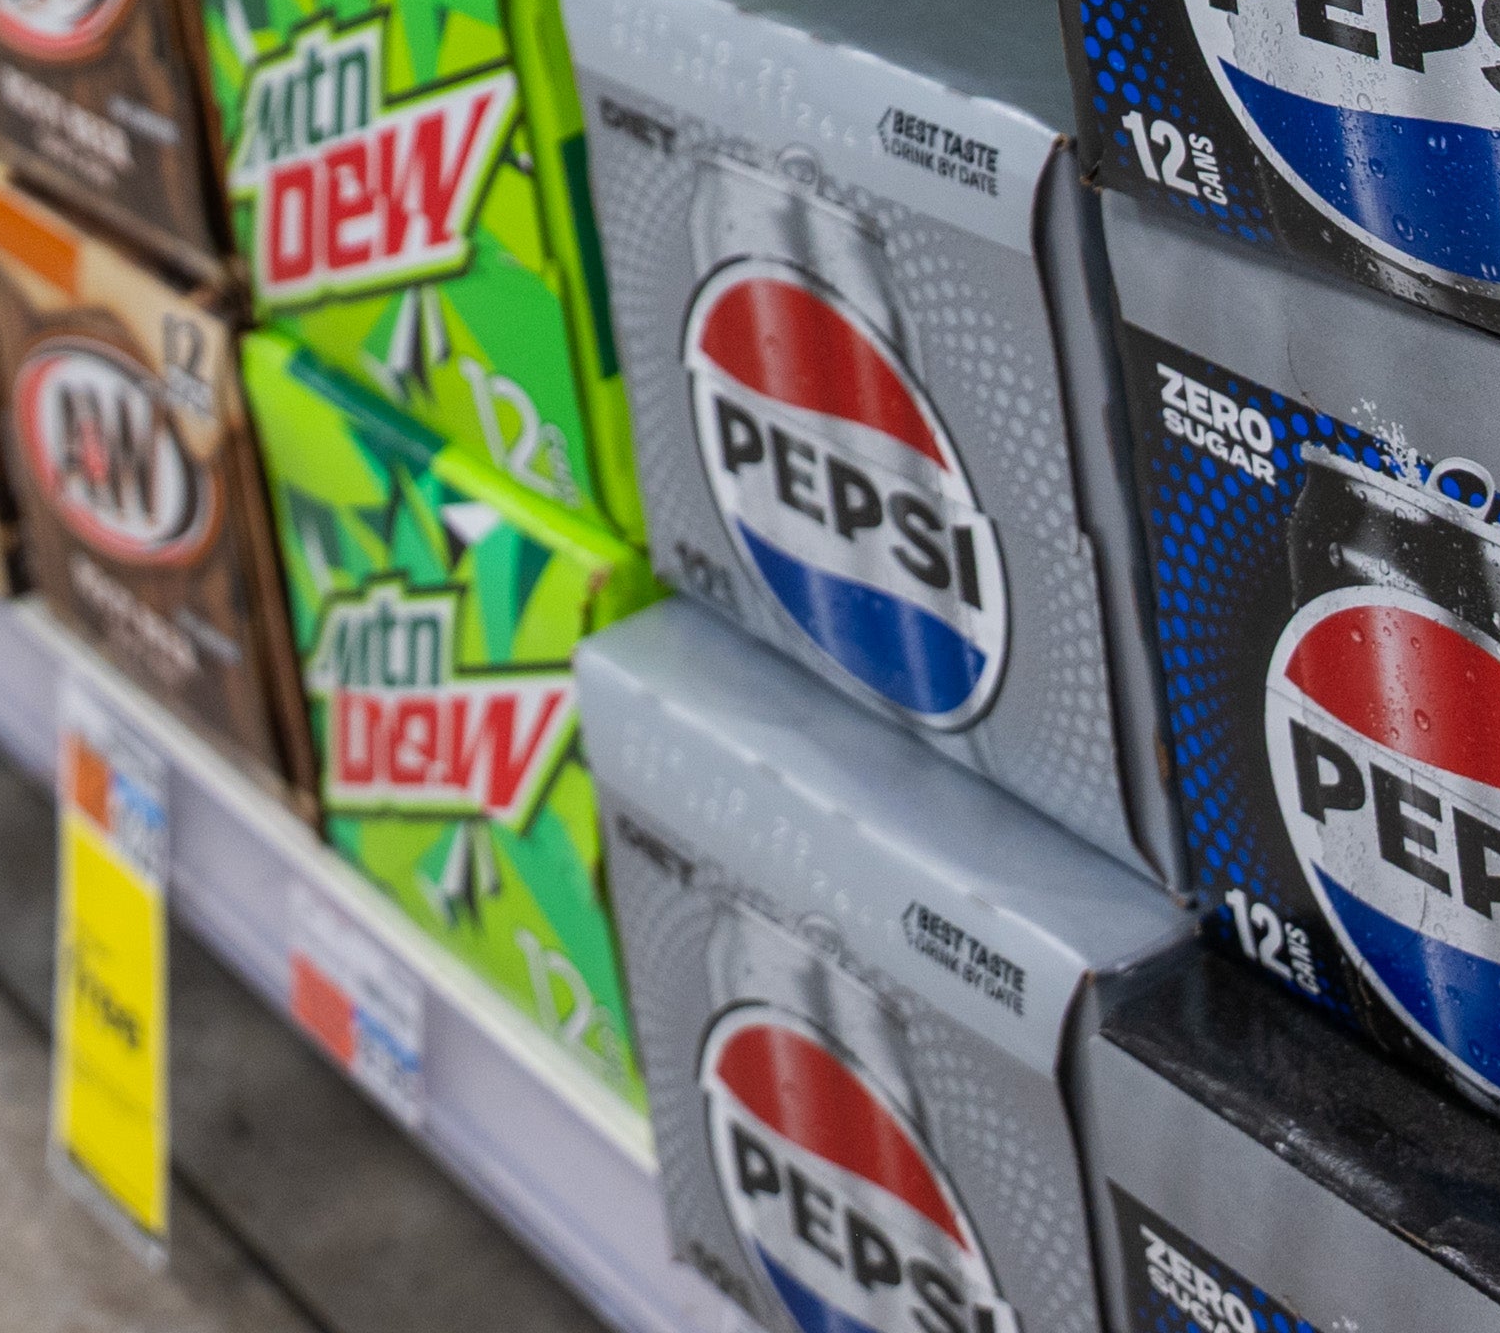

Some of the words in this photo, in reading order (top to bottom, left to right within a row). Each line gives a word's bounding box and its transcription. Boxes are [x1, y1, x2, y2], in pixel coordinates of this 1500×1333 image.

[892, 111, 939, 147] BEST
[943, 128, 999, 173] TASTE
[1121, 111, 1199, 198] 12
[1190, 133, 1229, 208] CANS
[1156, 362, 1274, 454] ZERO
[1162, 407, 1277, 487] SUGAR
[715, 396, 985, 612] PEPSI
[1224, 888, 1294, 982] 12
[1283, 921, 1322, 995] CANS
[1140, 1226, 1255, 1333] ZERO
